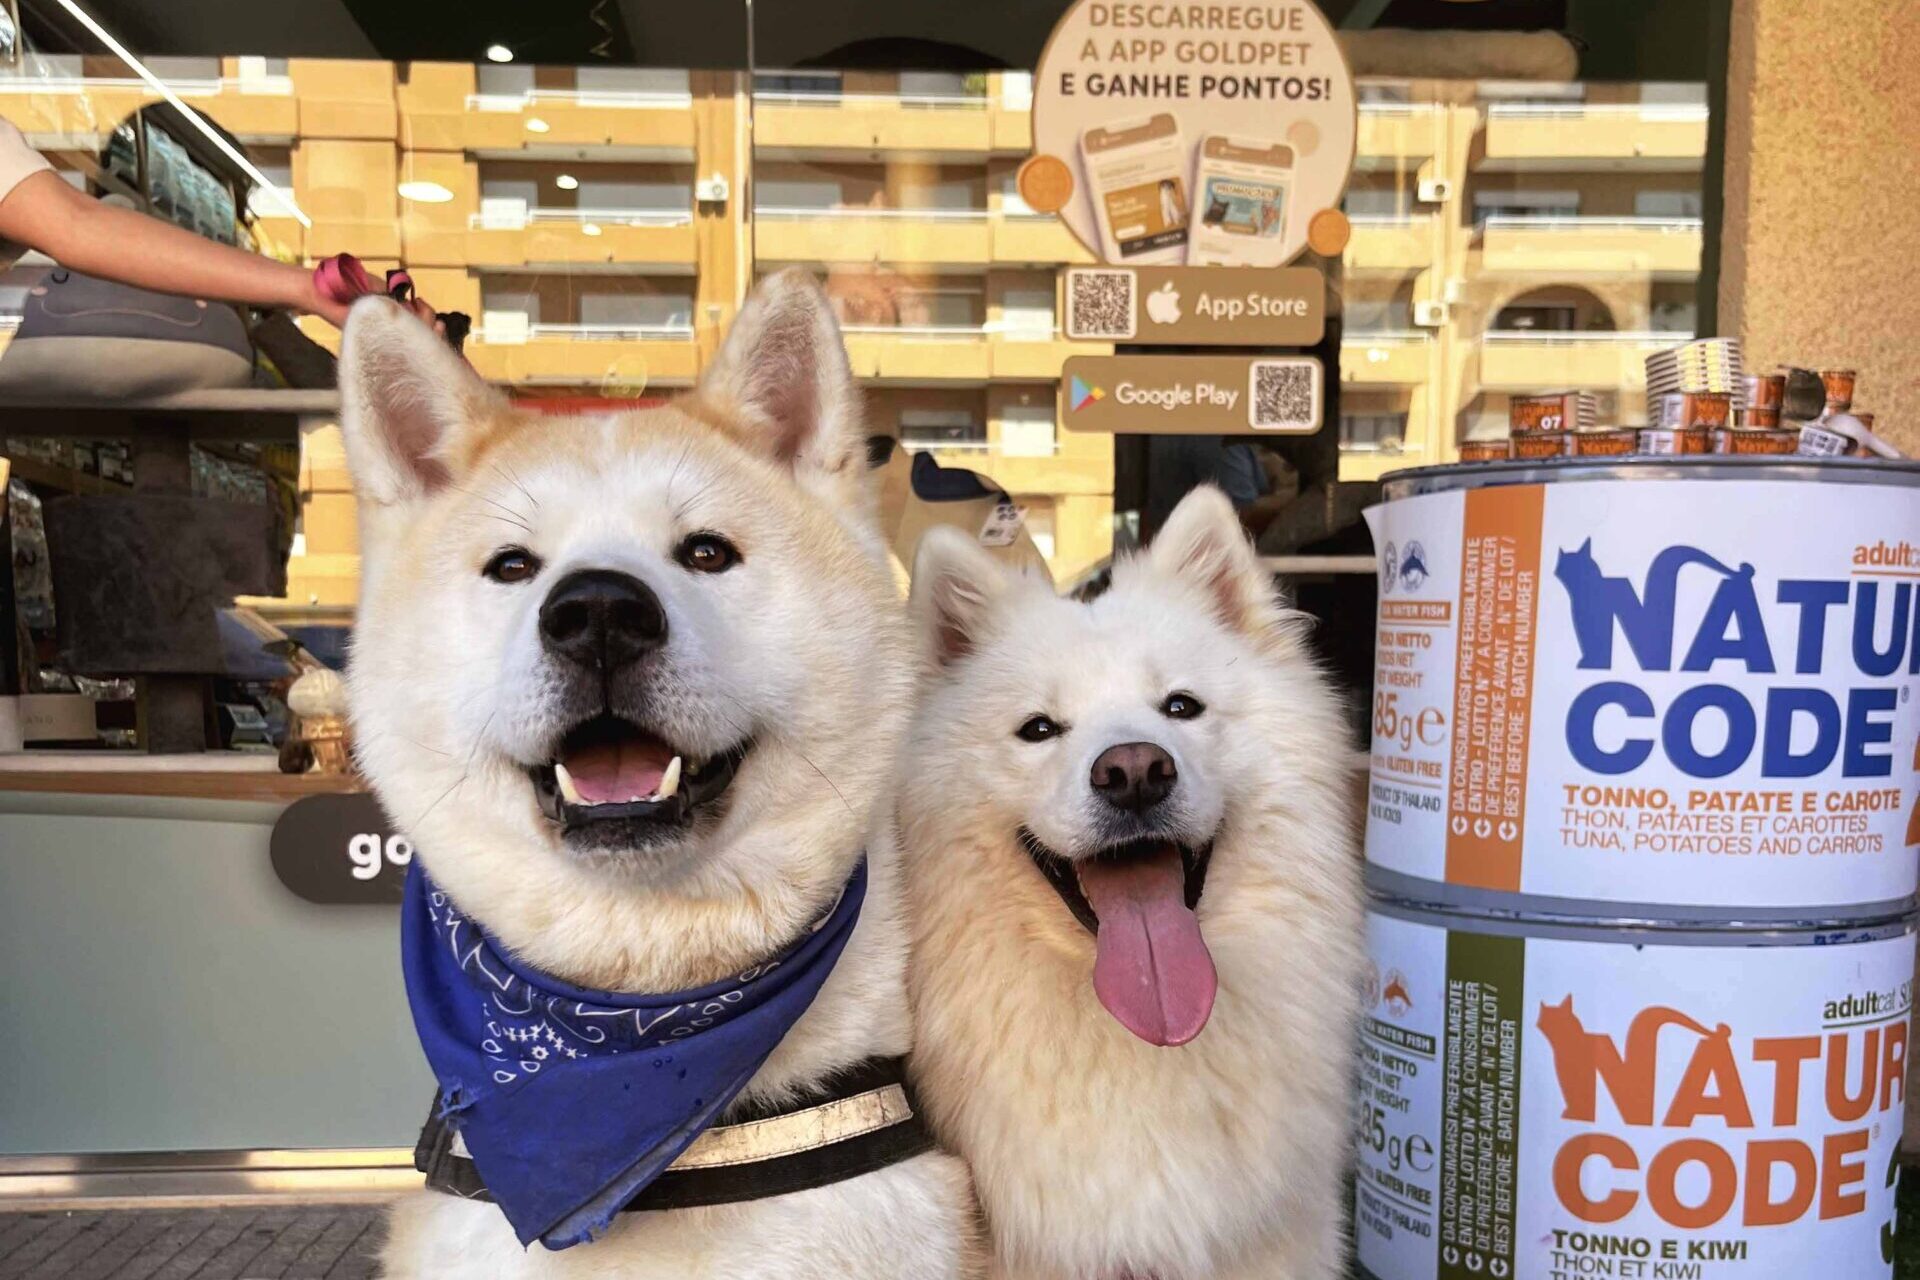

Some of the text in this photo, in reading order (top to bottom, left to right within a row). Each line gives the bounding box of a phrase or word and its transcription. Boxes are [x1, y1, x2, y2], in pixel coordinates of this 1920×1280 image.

[1089, 3, 1305, 31] DESCARREGUE
[1079, 38, 1312, 66] A APP GOLDPET
[1061, 73, 1332, 100] E GANHE PONTOS!
[1194, 293, 1308, 321] App Store
[1114, 381, 1240, 411] Google Play
[1541, 415, 1562, 430] 07
[1499, 546, 1516, 577] LOT
[1478, 536, 1497, 644] CONSOMMER
[1497, 579, 1513, 601] DE
[1421, 604, 1445, 618] FISH
[1514, 570, 1534, 642] NUMBER
[1396, 631, 1432, 649] NETTO
[1452, 537, 1480, 812] DA CONSUMARSI PREFERIBILMENTE
[1491, 637, 1509, 690] AVANT
[1510, 644, 1529, 698] BATCH
[1472, 693, 1488, 747] LOTTO
[1565, 681, 1898, 778] CODE
[1506, 710, 1525, 774] BEFORE
[1417, 760, 1443, 779] FREE
[1468, 759, 1484, 814] ENTRO
[1503, 775, 1520, 818] BEST
[1563, 785, 1901, 815] TONNO, PATATE E CAROTE
[1485, 794, 1500, 816] DE
[1561, 808, 1868, 835] THON, PATATES ET CAROTTES
[1560, 829, 1883, 855] TUNA, POTATOES AND CARROTS
[1482, 992, 1498, 1023] LOT
[1406, 1033, 1431, 1051] FISH
[1463, 981, 1480, 1084] CONSOMMER
[1481, 1023, 1497, 1048] DE
[1382, 1050, 1418, 1077] NETTO
[1499, 1019, 1516, 1089] NUMBER
[1443, 979, 1463, 1242] DA CONSUMARSI PREFERIBILMENTE
[1480, 1080, 1495, 1130] AVANT
[1498, 1089, 1514, 1142] BATCH
[1460, 1131, 1476, 1182] LOTTO
[1405, 1182, 1432, 1206] FREE
[1495, 1152, 1512, 1213] BEFORE
[1552, 1128, 1870, 1229] CODE
[1458, 1194, 1473, 1247] ENTRO
[1494, 1213, 1510, 1256] BEST
[1475, 1228, 1490, 1251] DE
[1551, 1229, 1748, 1261] TONNO E KIWI
[1550, 1250, 1612, 1275] THON
[1619, 1259, 1648, 1278] ET
[1653, 1262, 1702, 1280] KIWI
